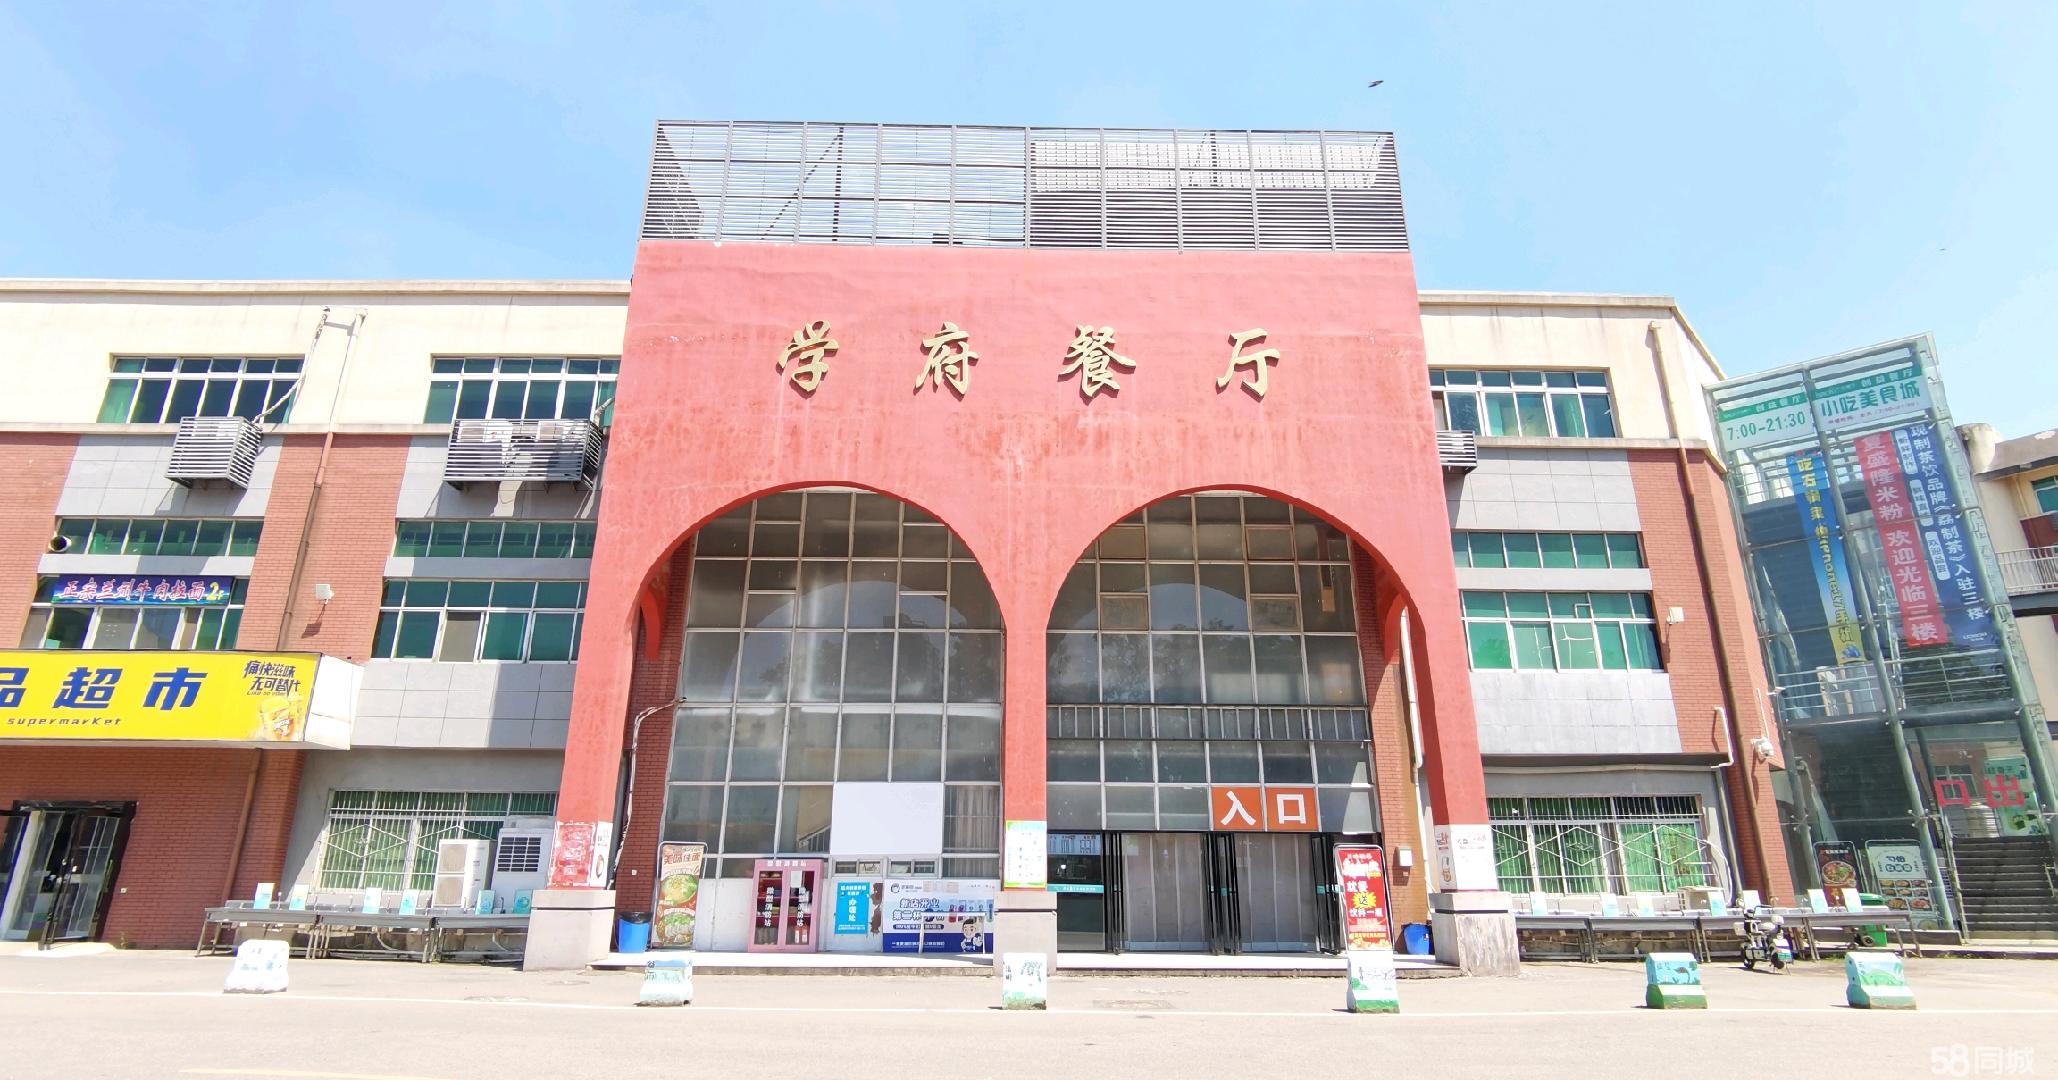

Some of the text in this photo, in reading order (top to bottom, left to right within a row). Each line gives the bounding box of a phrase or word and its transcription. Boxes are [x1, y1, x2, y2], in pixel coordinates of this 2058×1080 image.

[777, 319, 1280, 401] 学府餐厅
[1820, 379, 1921, 417] 小吃美食城
[1727, 411, 1806, 441] 7:00-21:30
[62, 577, 205, 601] 正宗兰州牛肉拉面
[1887, 531, 1938, 641] 欢迎光临三楼
[1220, 790, 1306, 826] 入口
[900, 898, 940, 909] 新店开业
